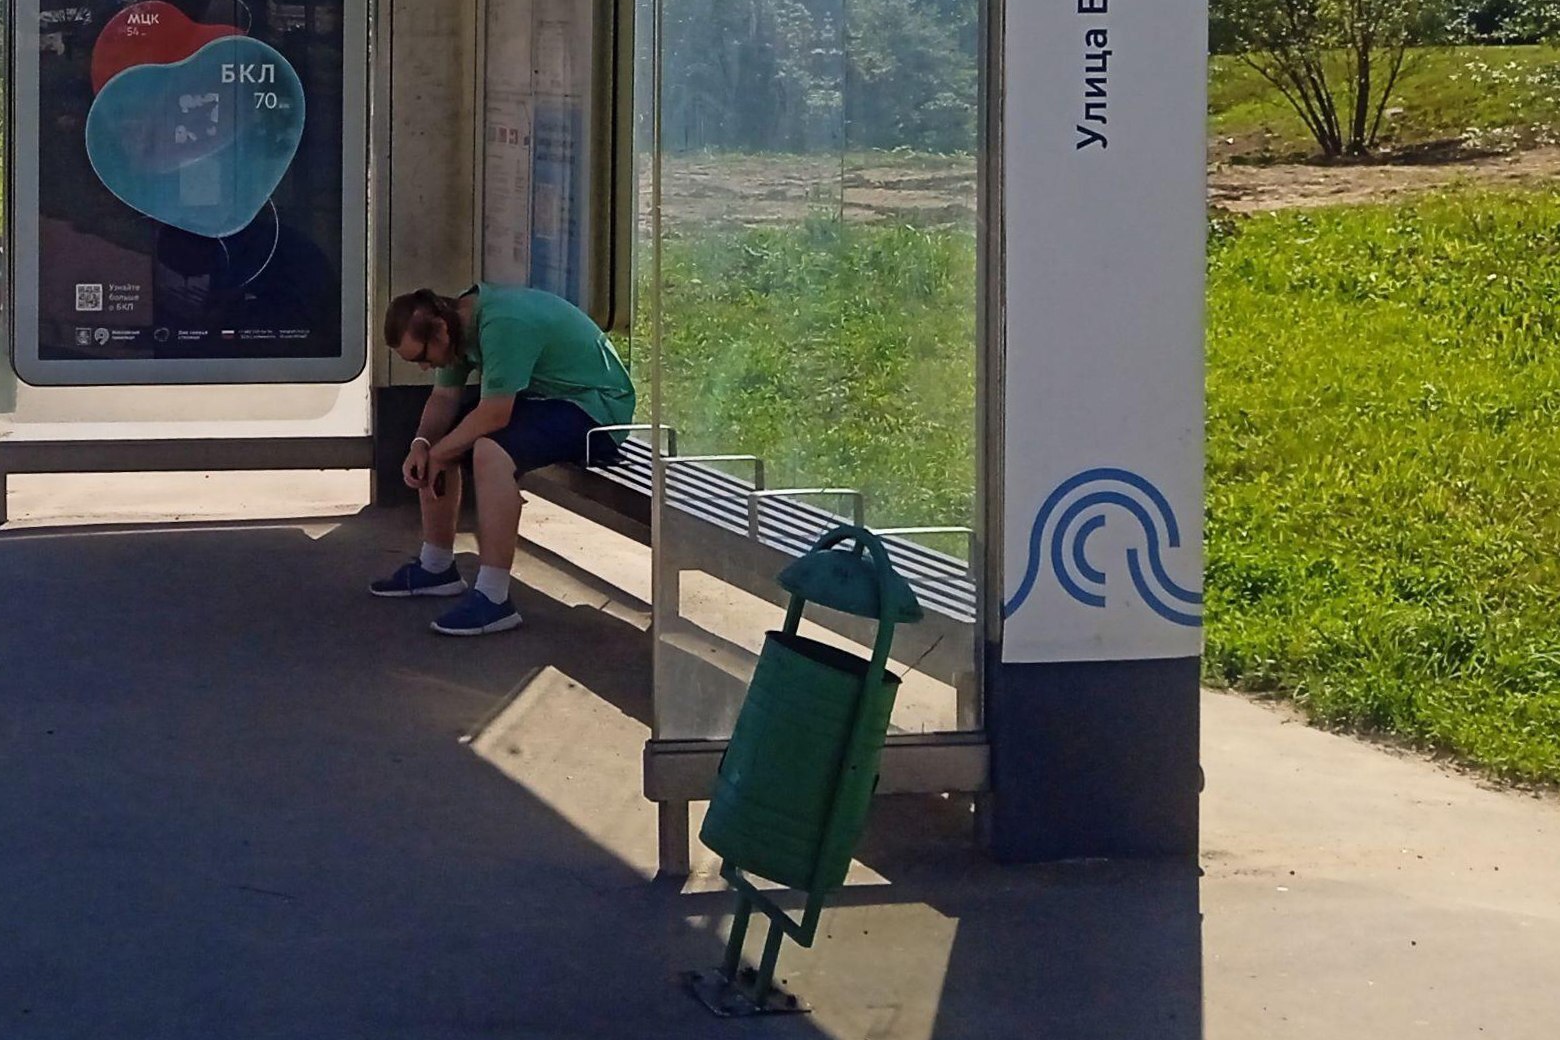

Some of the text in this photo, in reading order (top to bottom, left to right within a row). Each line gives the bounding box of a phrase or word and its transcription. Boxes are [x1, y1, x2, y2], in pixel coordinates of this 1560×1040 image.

[127, 13, 160, 26] МЦК
[126, 26, 139, 37] 54
[220, 63, 276, 84] БКЛ
[1075, 28, 1113, 150] Улица
[253, 91, 278, 109] 70
[116, 303, 134, 311] БКЛ
